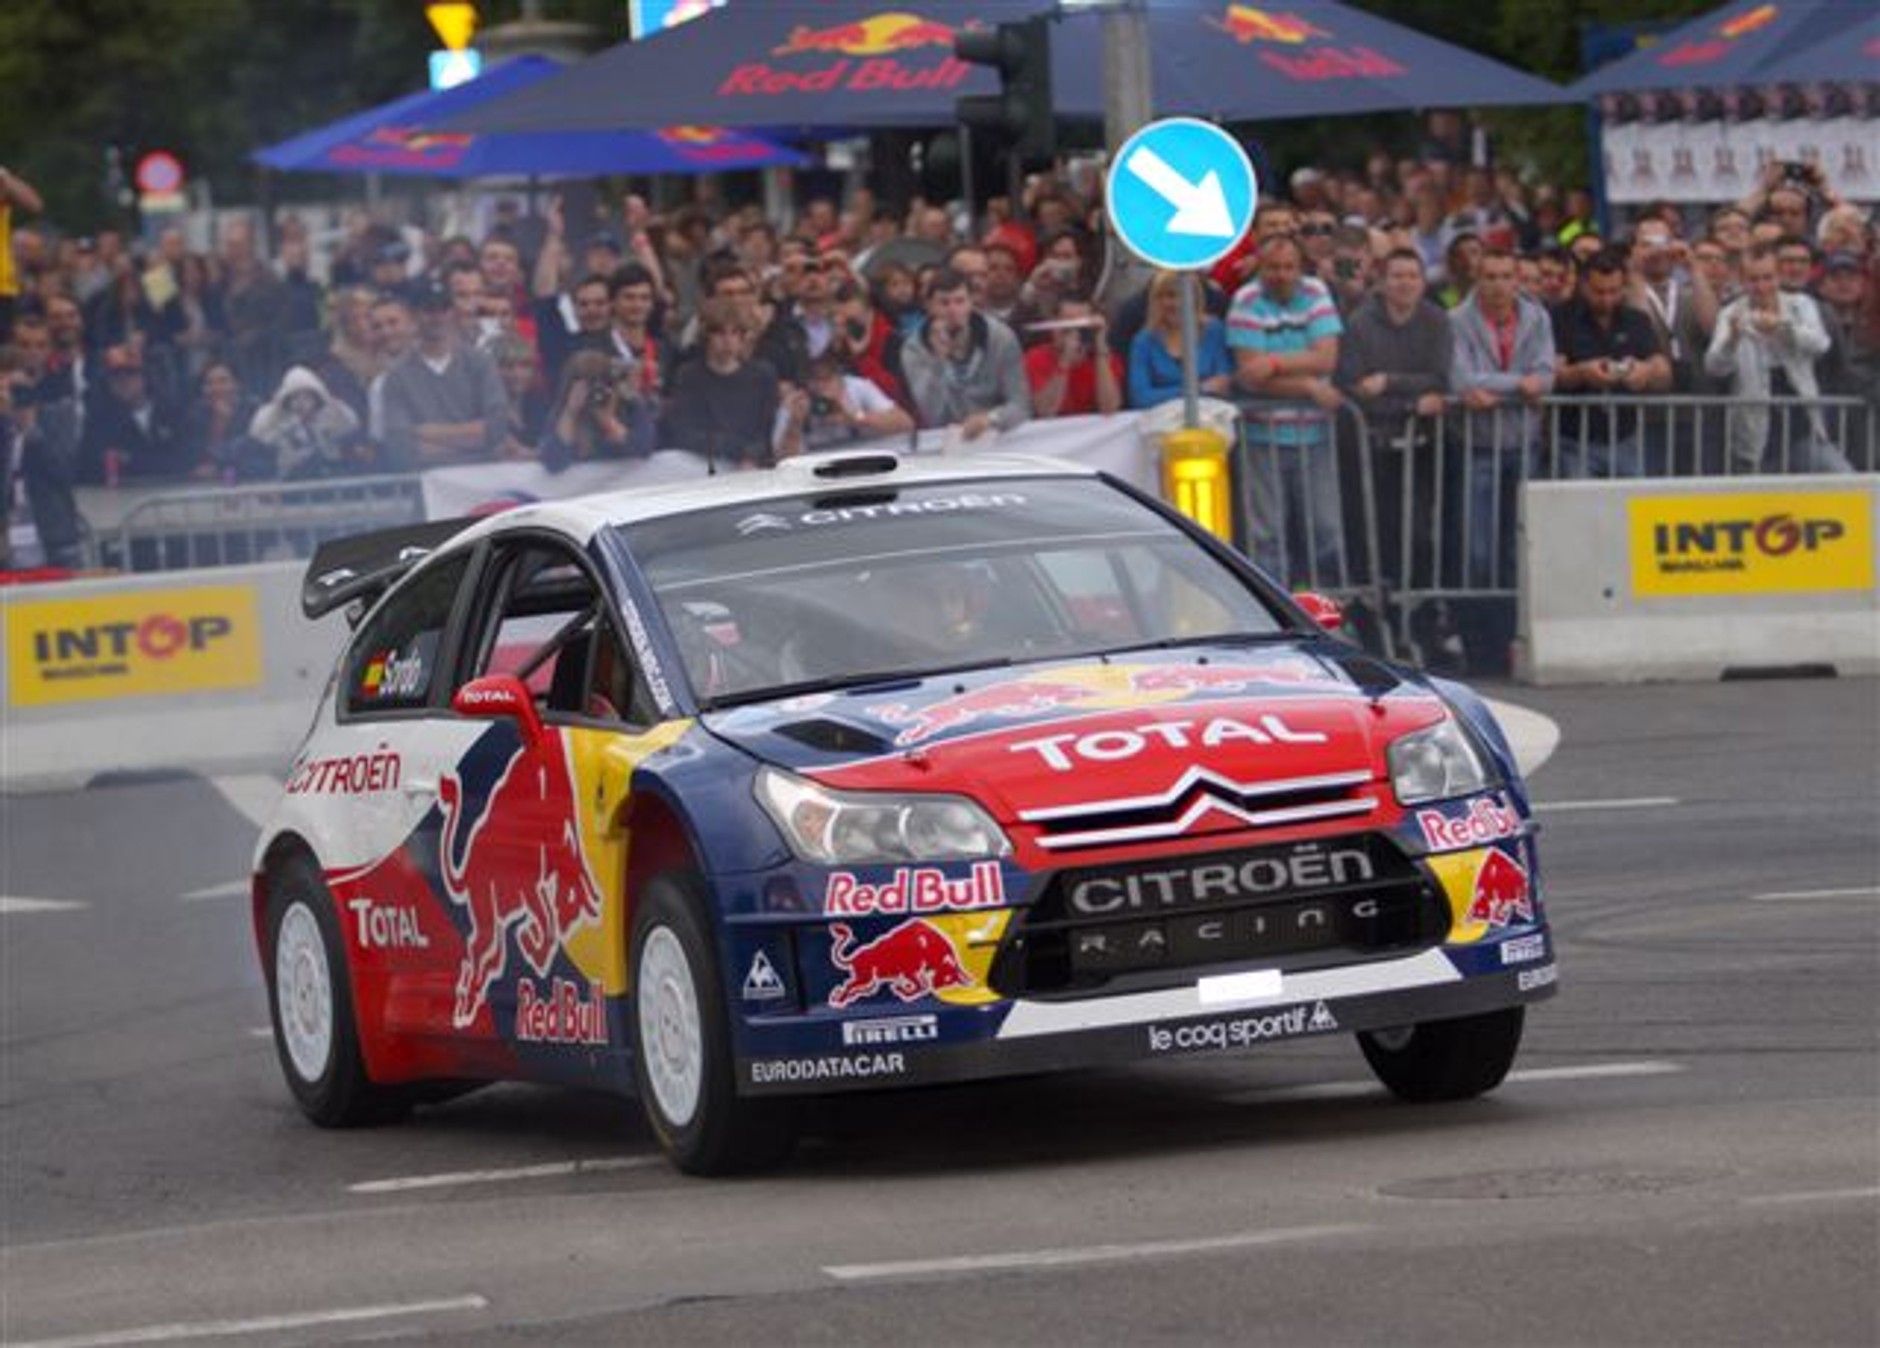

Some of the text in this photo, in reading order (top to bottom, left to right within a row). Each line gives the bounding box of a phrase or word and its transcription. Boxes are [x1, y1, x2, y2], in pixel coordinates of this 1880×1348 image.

[718, 56, 972, 95] Red Bull
[1655, 514, 1845, 557] INTOP
[33, 614, 232, 663] INTOP
[464, 690, 516, 703] TOTAL
[1009, 713, 1329, 772] TOTAL
[1416, 799, 1500, 851] Red
[825, 861, 1004, 917] Red Bull
[1072, 844, 1374, 913] CITROËN
[349, 898, 429, 948] TOTAL
[1080, 899, 1378, 953] RACING
[517, 977, 608, 1043] Red Bull
[843, 1014, 938, 1045] PIRELLI
[1149, 1007, 1306, 1050] le coq sportif
[751, 1053, 905, 1082] EURODATACAR
